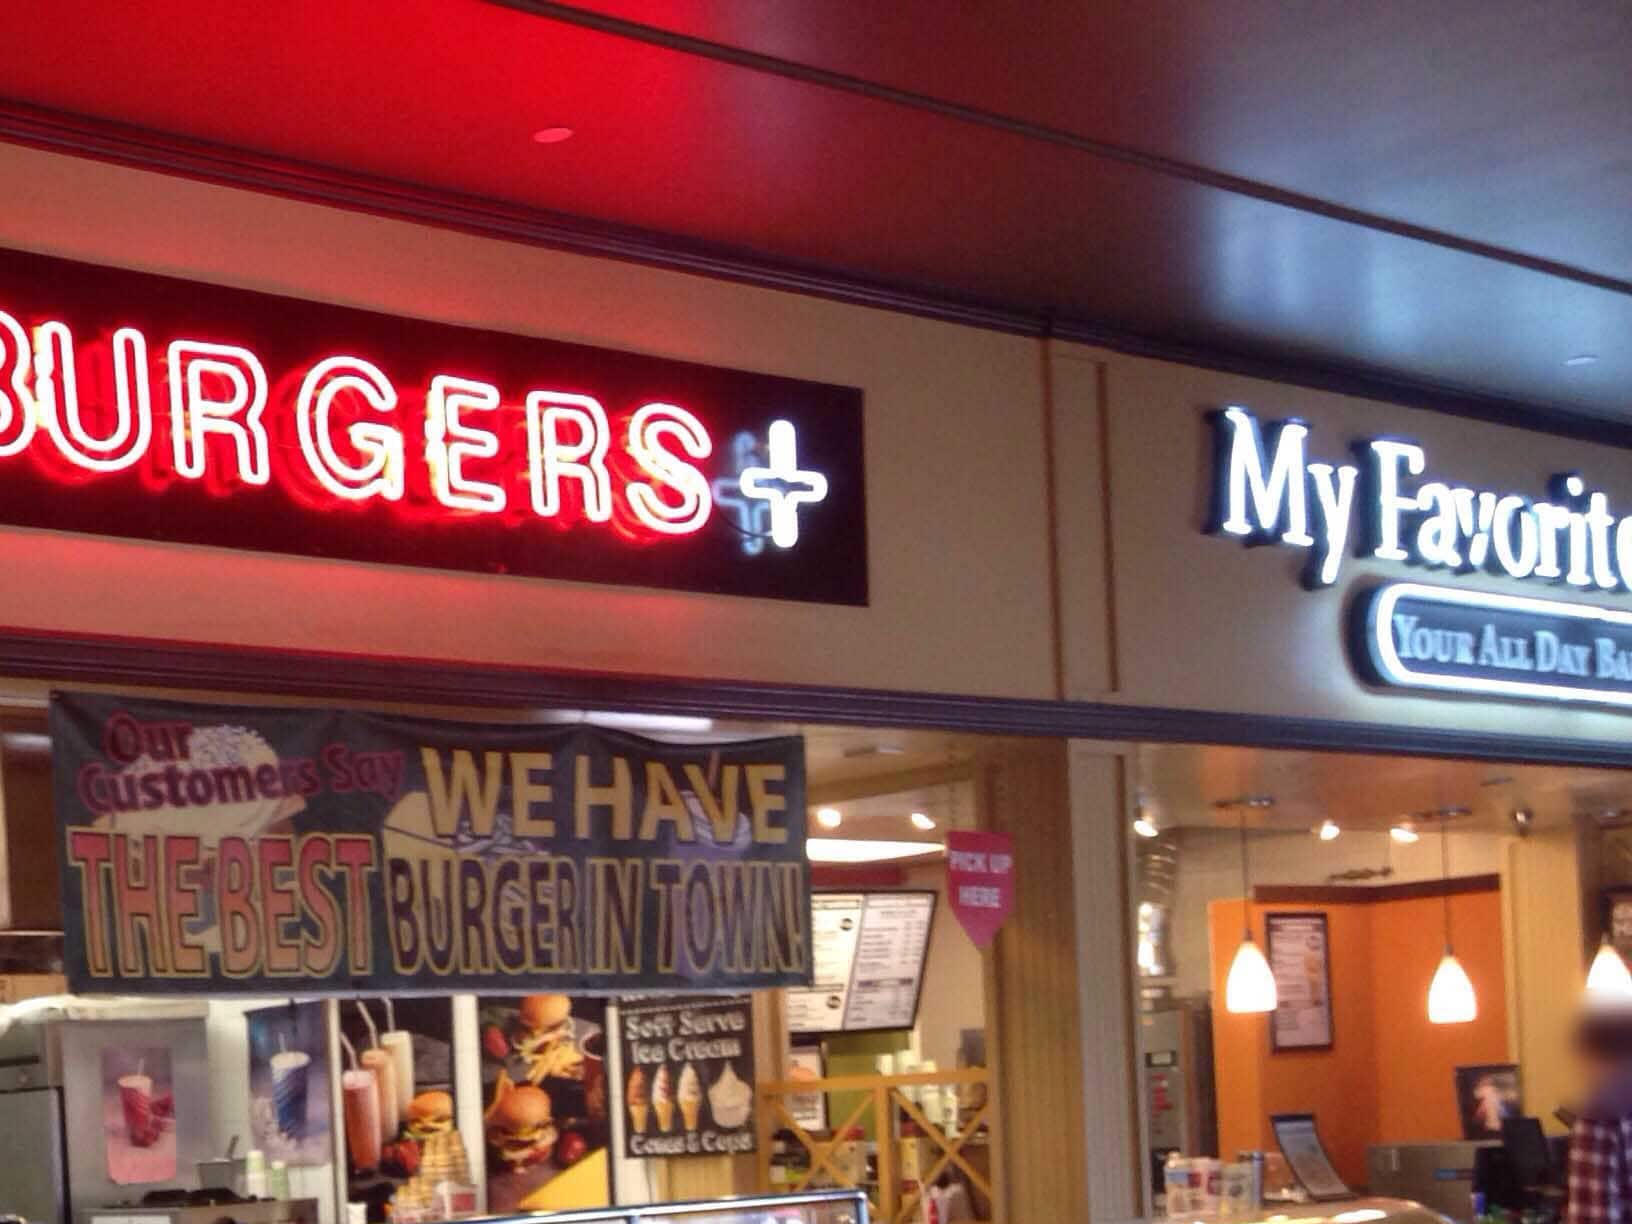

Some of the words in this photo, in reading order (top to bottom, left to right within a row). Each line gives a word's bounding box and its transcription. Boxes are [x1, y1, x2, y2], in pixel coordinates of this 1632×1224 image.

[1222, 406, 1359, 586] My
[104, 709, 192, 763] Our
[78, 758, 322, 814] Customers
[322, 742, 408, 798] Say
[420, 746, 556, 838] WE
[574, 756, 788, 844] HAVE
[66, 824, 212, 982] THE
[218, 832, 374, 980] BEST
[384, 858, 579, 978] BURGER
[584, 858, 644, 976] IN
[626, 1016, 674, 1040] Soft
[679, 1010, 745, 1036] Serve
[632, 1041, 665, 1065] Ice
[668, 1037, 741, 1061] Cream
